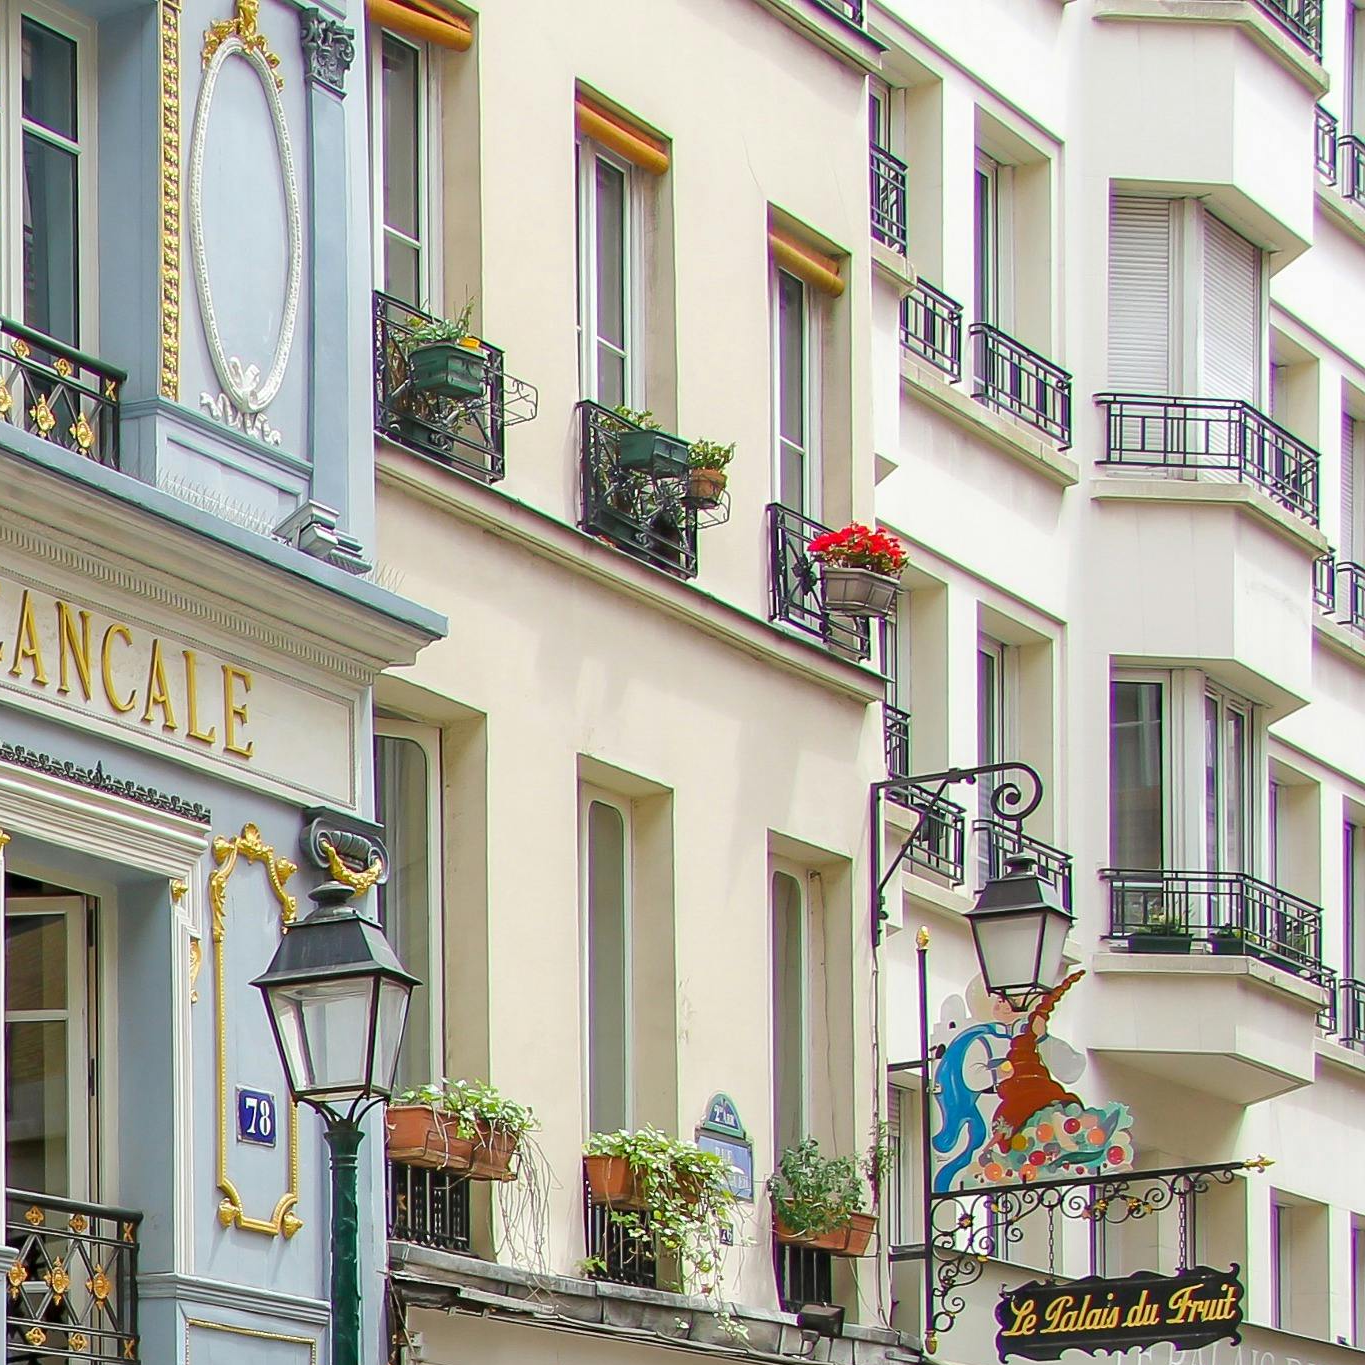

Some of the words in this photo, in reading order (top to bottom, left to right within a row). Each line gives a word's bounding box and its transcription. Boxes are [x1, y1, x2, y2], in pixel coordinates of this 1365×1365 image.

[245, 1097, 271, 1136] 78
[1002, 1297, 1038, 1336] Le
[1040, 1293, 1120, 1334] Palais
[1121, 1290, 1160, 1327] du
[1166, 1283, 1237, 1325] Fruit
